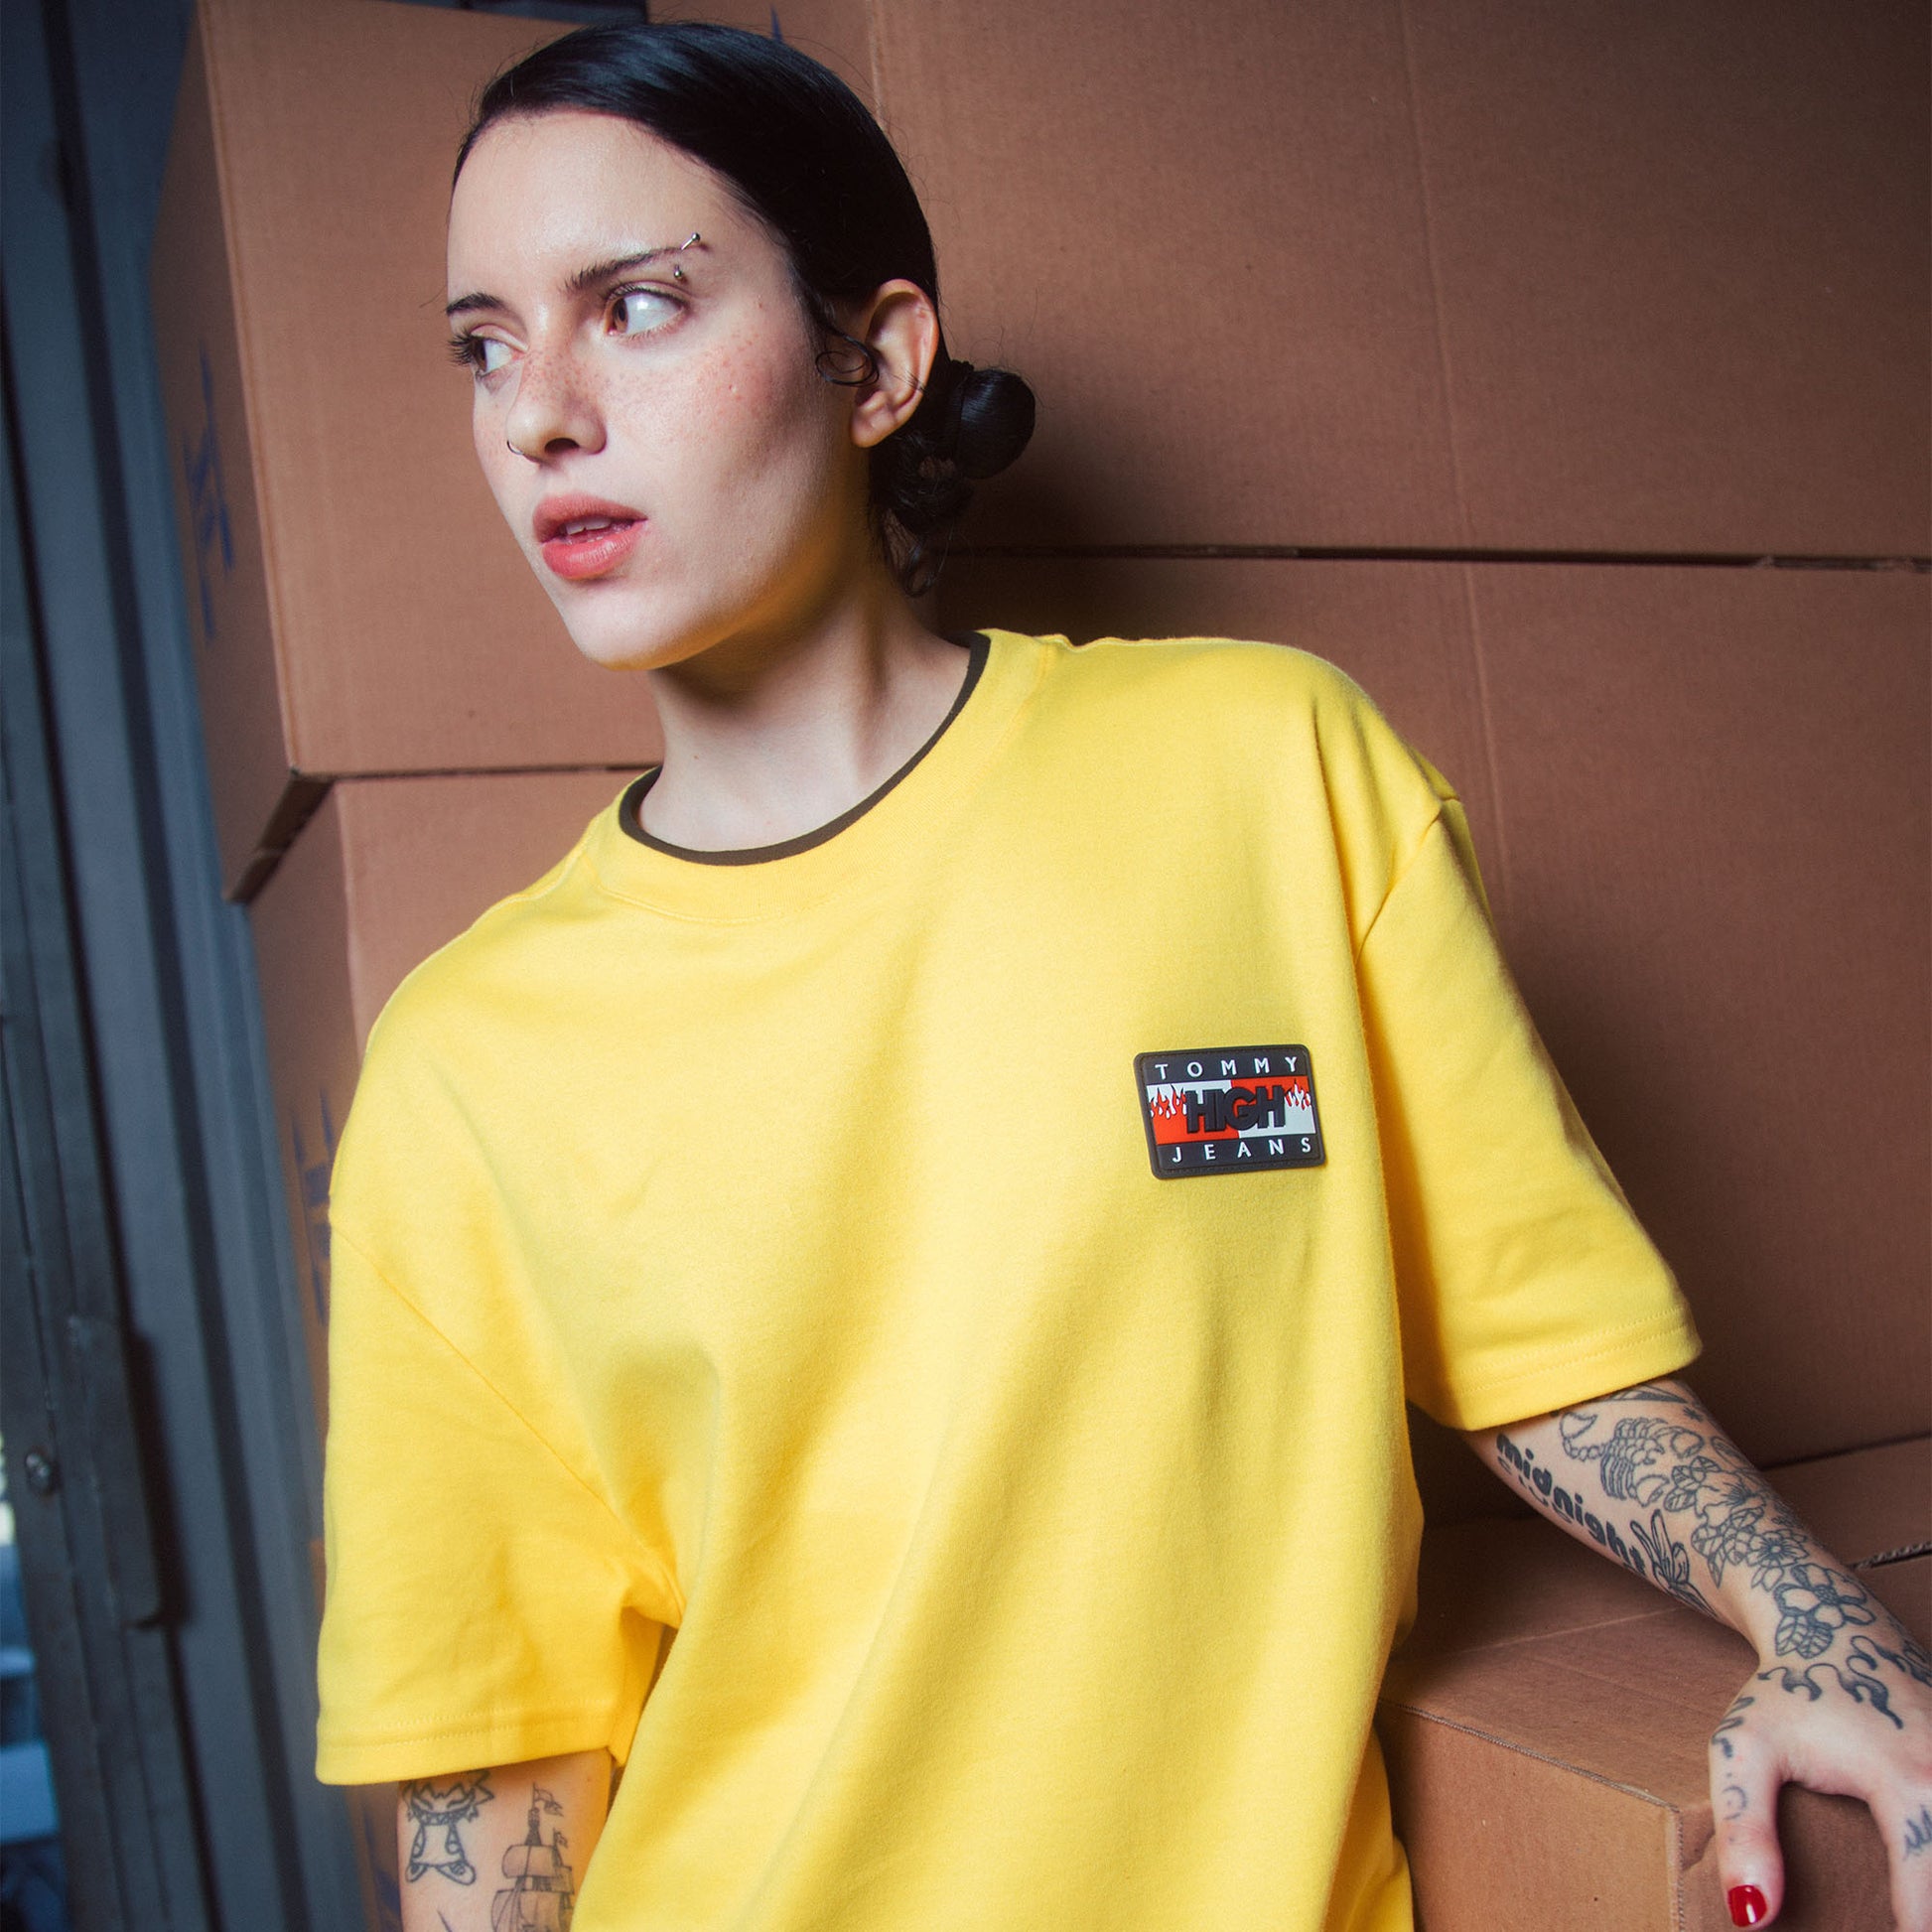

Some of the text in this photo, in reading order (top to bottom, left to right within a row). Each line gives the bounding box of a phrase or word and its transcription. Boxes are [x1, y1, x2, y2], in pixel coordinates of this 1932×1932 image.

[1155, 1056, 1297, 1080] TOMMY
[1186, 1085, 1286, 1134] HIGH
[1173, 1137, 1311, 1163] JEANS
